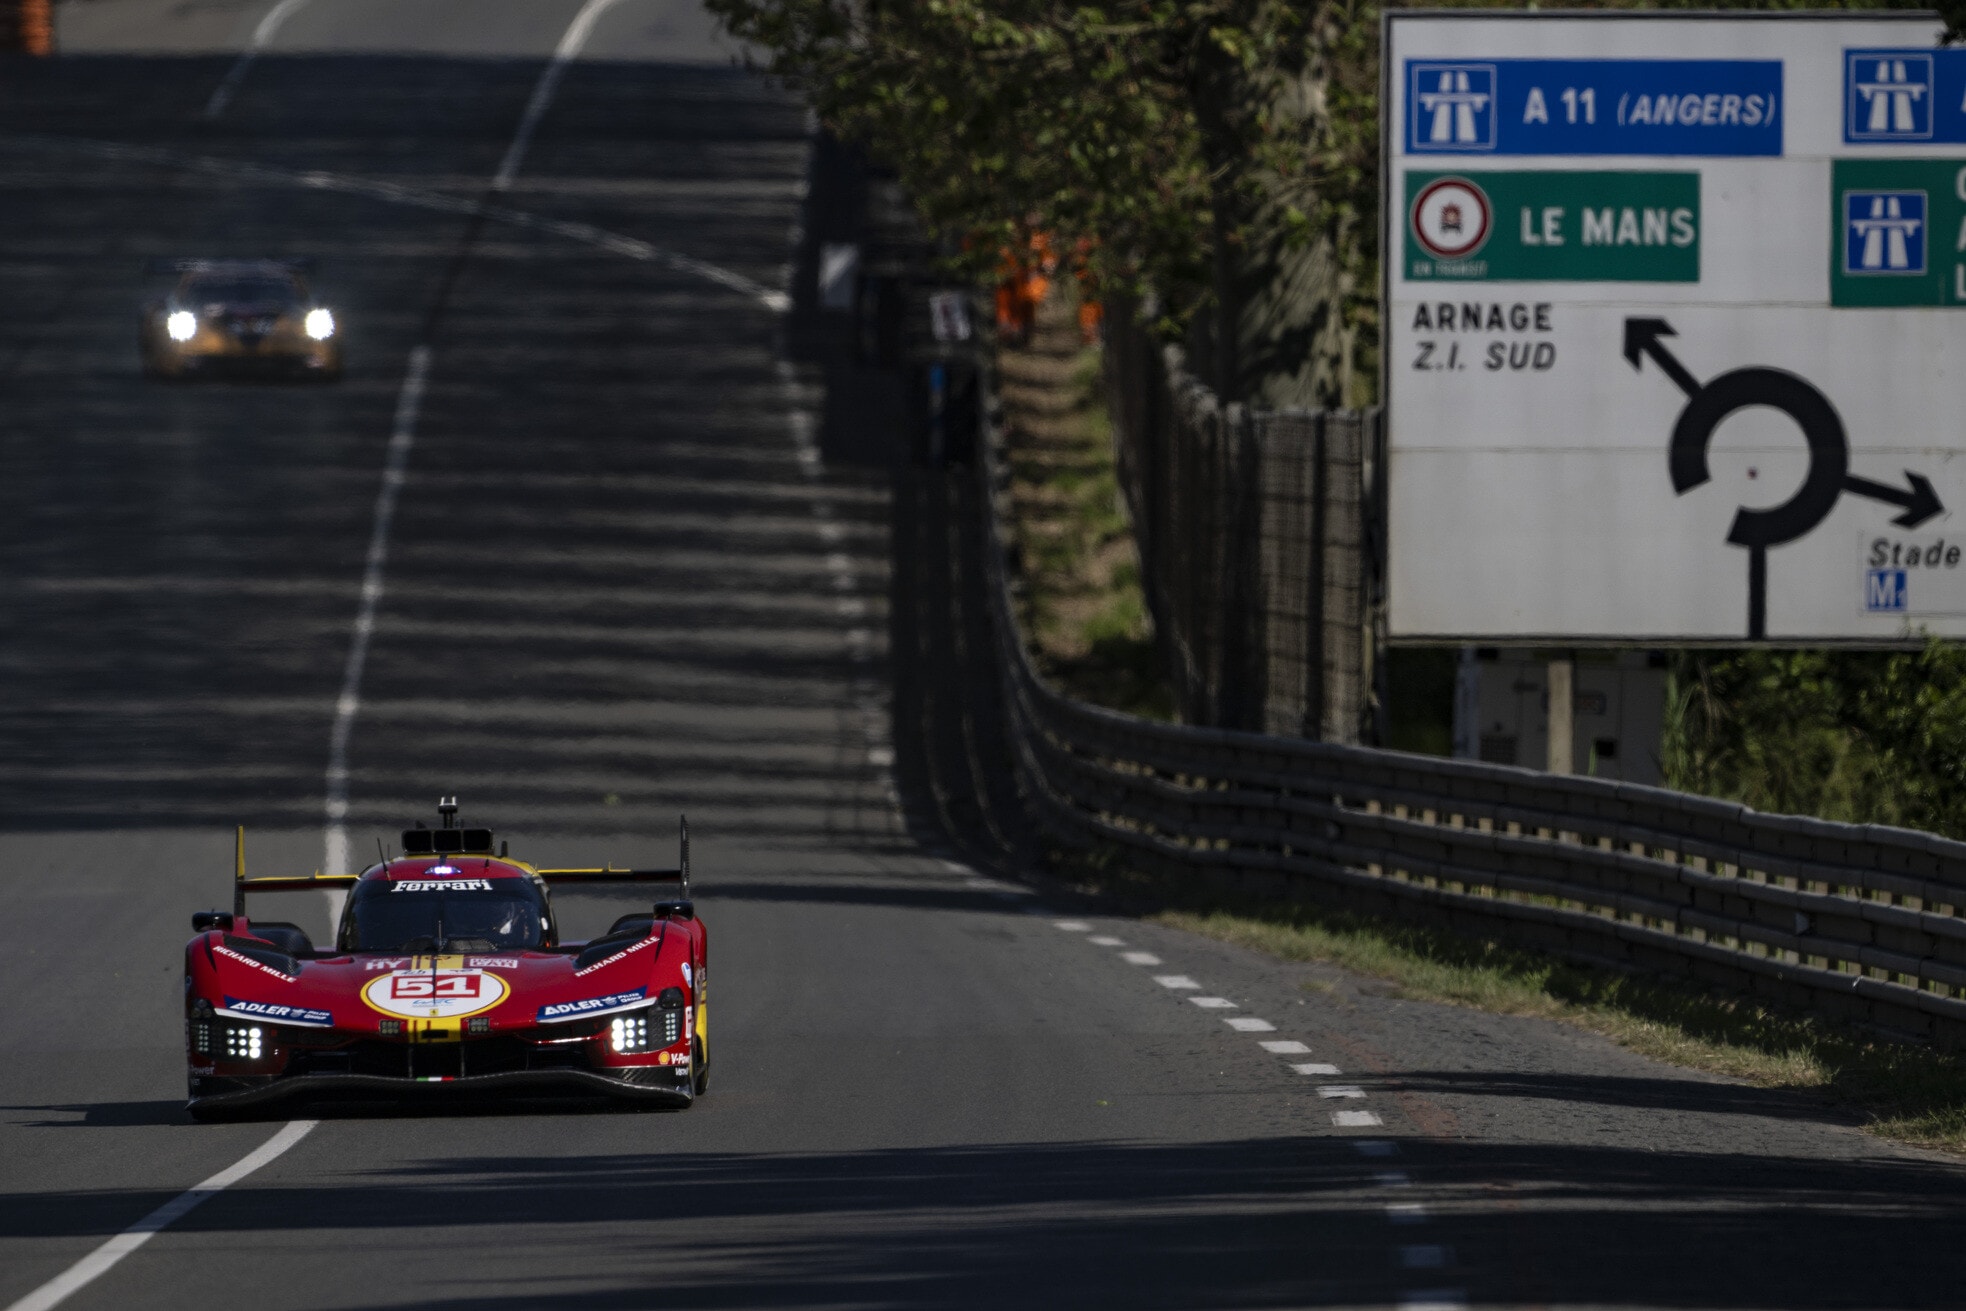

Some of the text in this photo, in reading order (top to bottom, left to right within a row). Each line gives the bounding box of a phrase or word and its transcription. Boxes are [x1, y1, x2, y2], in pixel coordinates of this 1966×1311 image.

[1523, 86, 1776, 128] A 11 (ANGERS)
[1520, 206, 1695, 246] LE MANS
[1412, 302, 1554, 332] ARNAGE
[1412, 341, 1557, 371] Z.I. SUD
[1868, 537, 1962, 568] Stade
[391, 879, 494, 893] Ferrari
[212, 945, 297, 984] RICHARD MILLE
[574, 935, 661, 978] RICHARD MILLE
[395, 976, 476, 997] 51
[229, 1001, 291, 1017] ADLER
[544, 998, 604, 1016] ADLER
